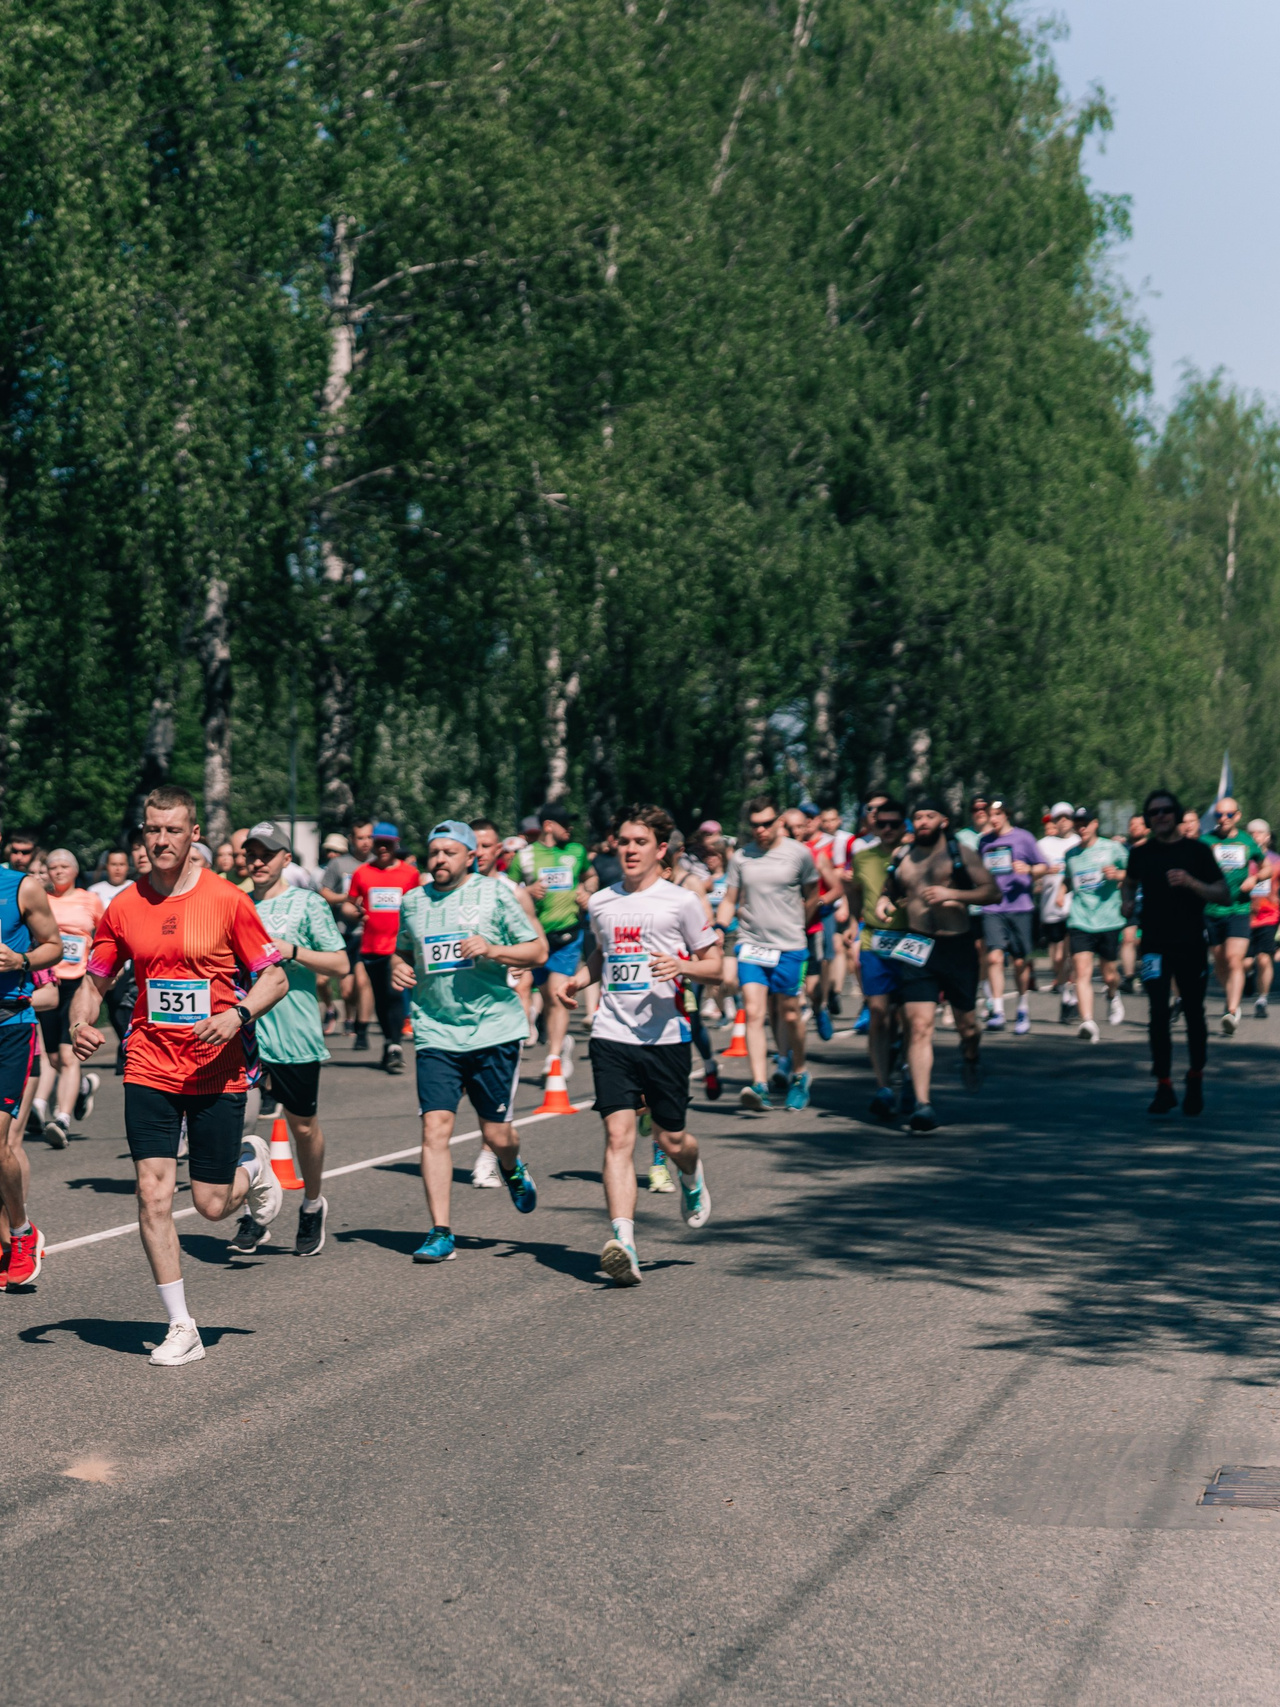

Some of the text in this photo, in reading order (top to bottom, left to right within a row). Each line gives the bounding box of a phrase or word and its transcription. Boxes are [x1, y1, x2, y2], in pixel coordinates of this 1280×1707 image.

[431, 942, 462, 961] 876
[612, 964, 640, 982] 807
[159, 991, 196, 1013] 531
